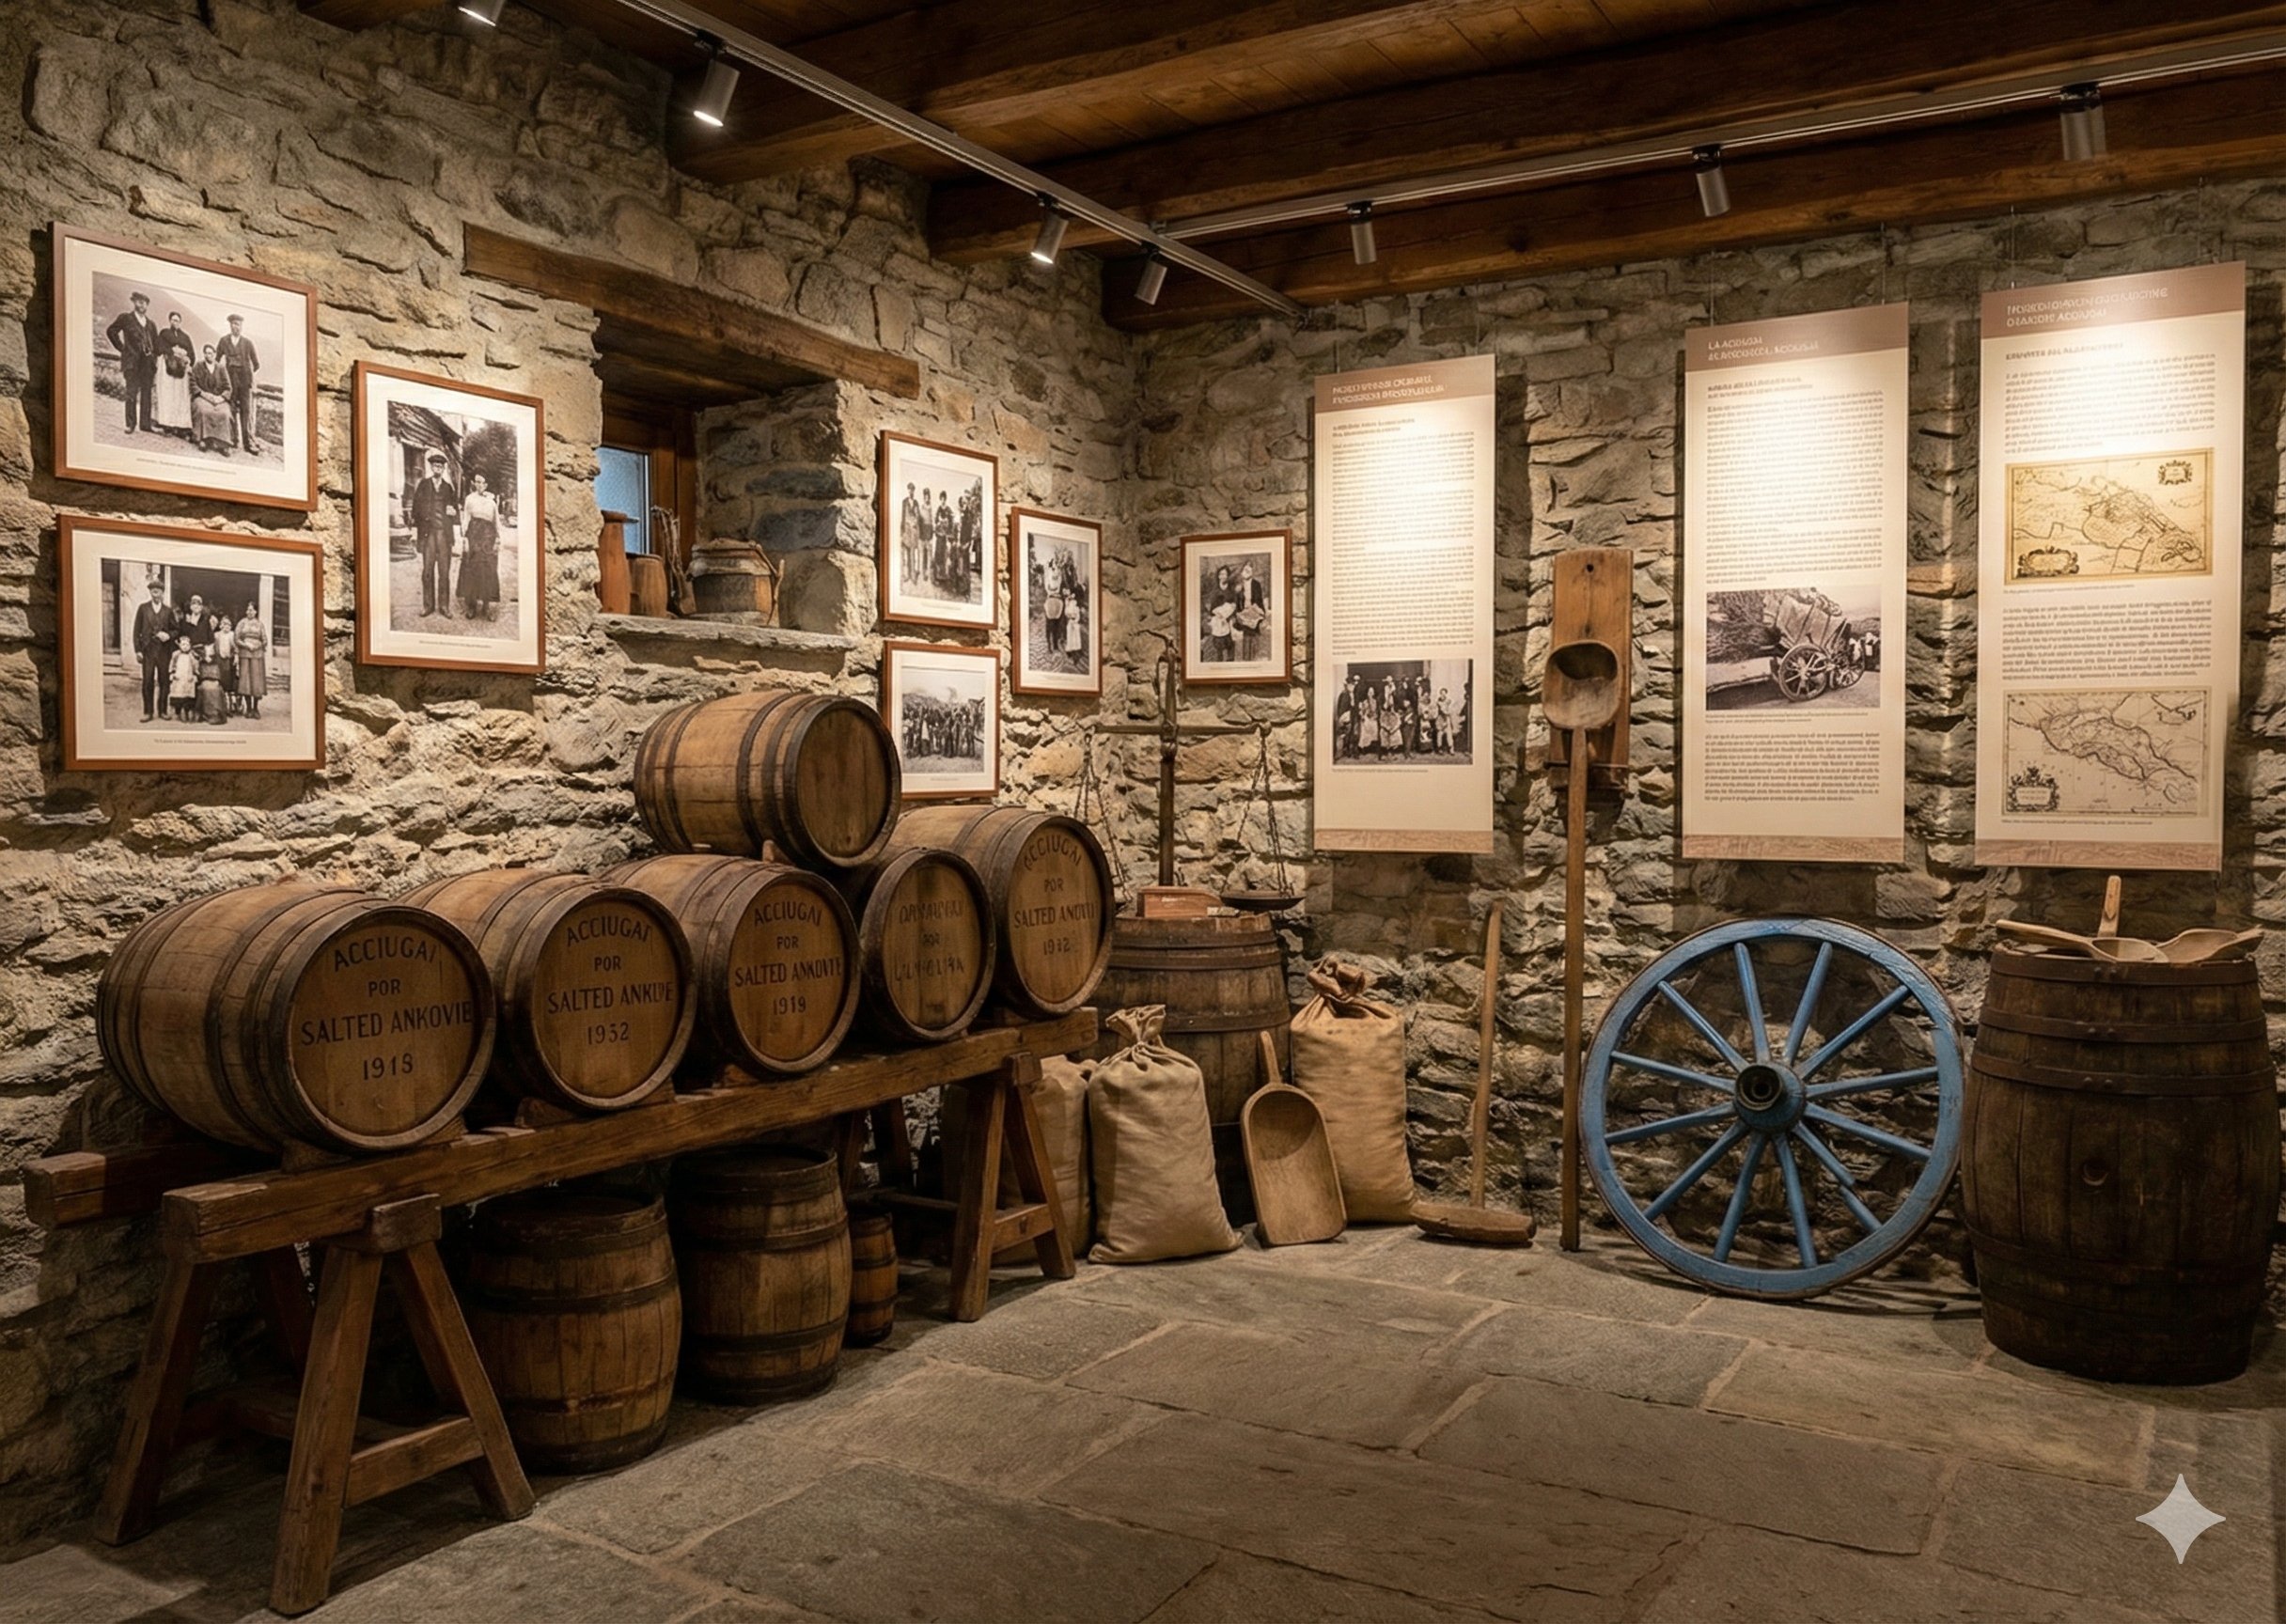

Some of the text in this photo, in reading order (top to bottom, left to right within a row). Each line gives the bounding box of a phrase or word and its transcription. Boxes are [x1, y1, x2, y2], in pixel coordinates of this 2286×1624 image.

[754, 901, 822, 927] ACCIUGAI
[1013, 906, 1056, 929] SALTED
[567, 915, 651, 947] ACCIUGAI
[335, 936, 436, 972] ACCIUGAI
[594, 955, 621, 972] POR
[735, 962, 787, 987] SALTED
[368, 978, 401, 998] POR
[547, 986, 614, 1014] SALTED
[301, 1013, 383, 1047] SALTED
[587, 1022, 629, 1045] 1952
